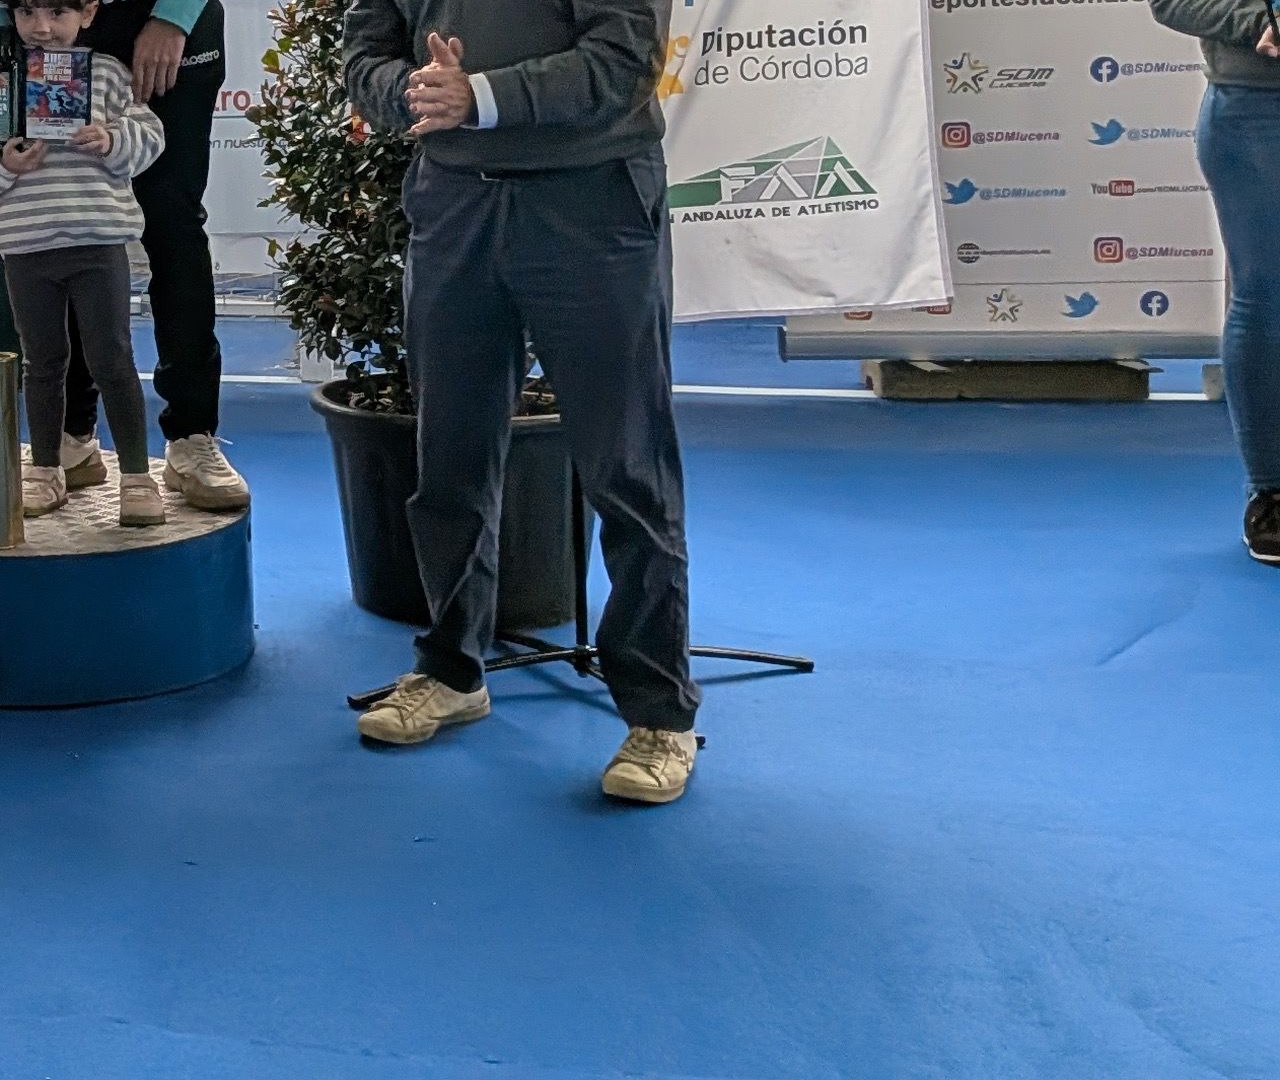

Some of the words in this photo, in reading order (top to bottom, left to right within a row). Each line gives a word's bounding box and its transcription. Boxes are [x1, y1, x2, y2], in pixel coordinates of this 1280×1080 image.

[701, 19, 868, 57] Diputación
[695, 58, 729, 87] de
[740, 50, 869, 83] Córdoba
[681, 206, 765, 224] ANDALUZA
[771, 206, 791, 217] DE
[797, 198, 880, 216] ATLETISMO
